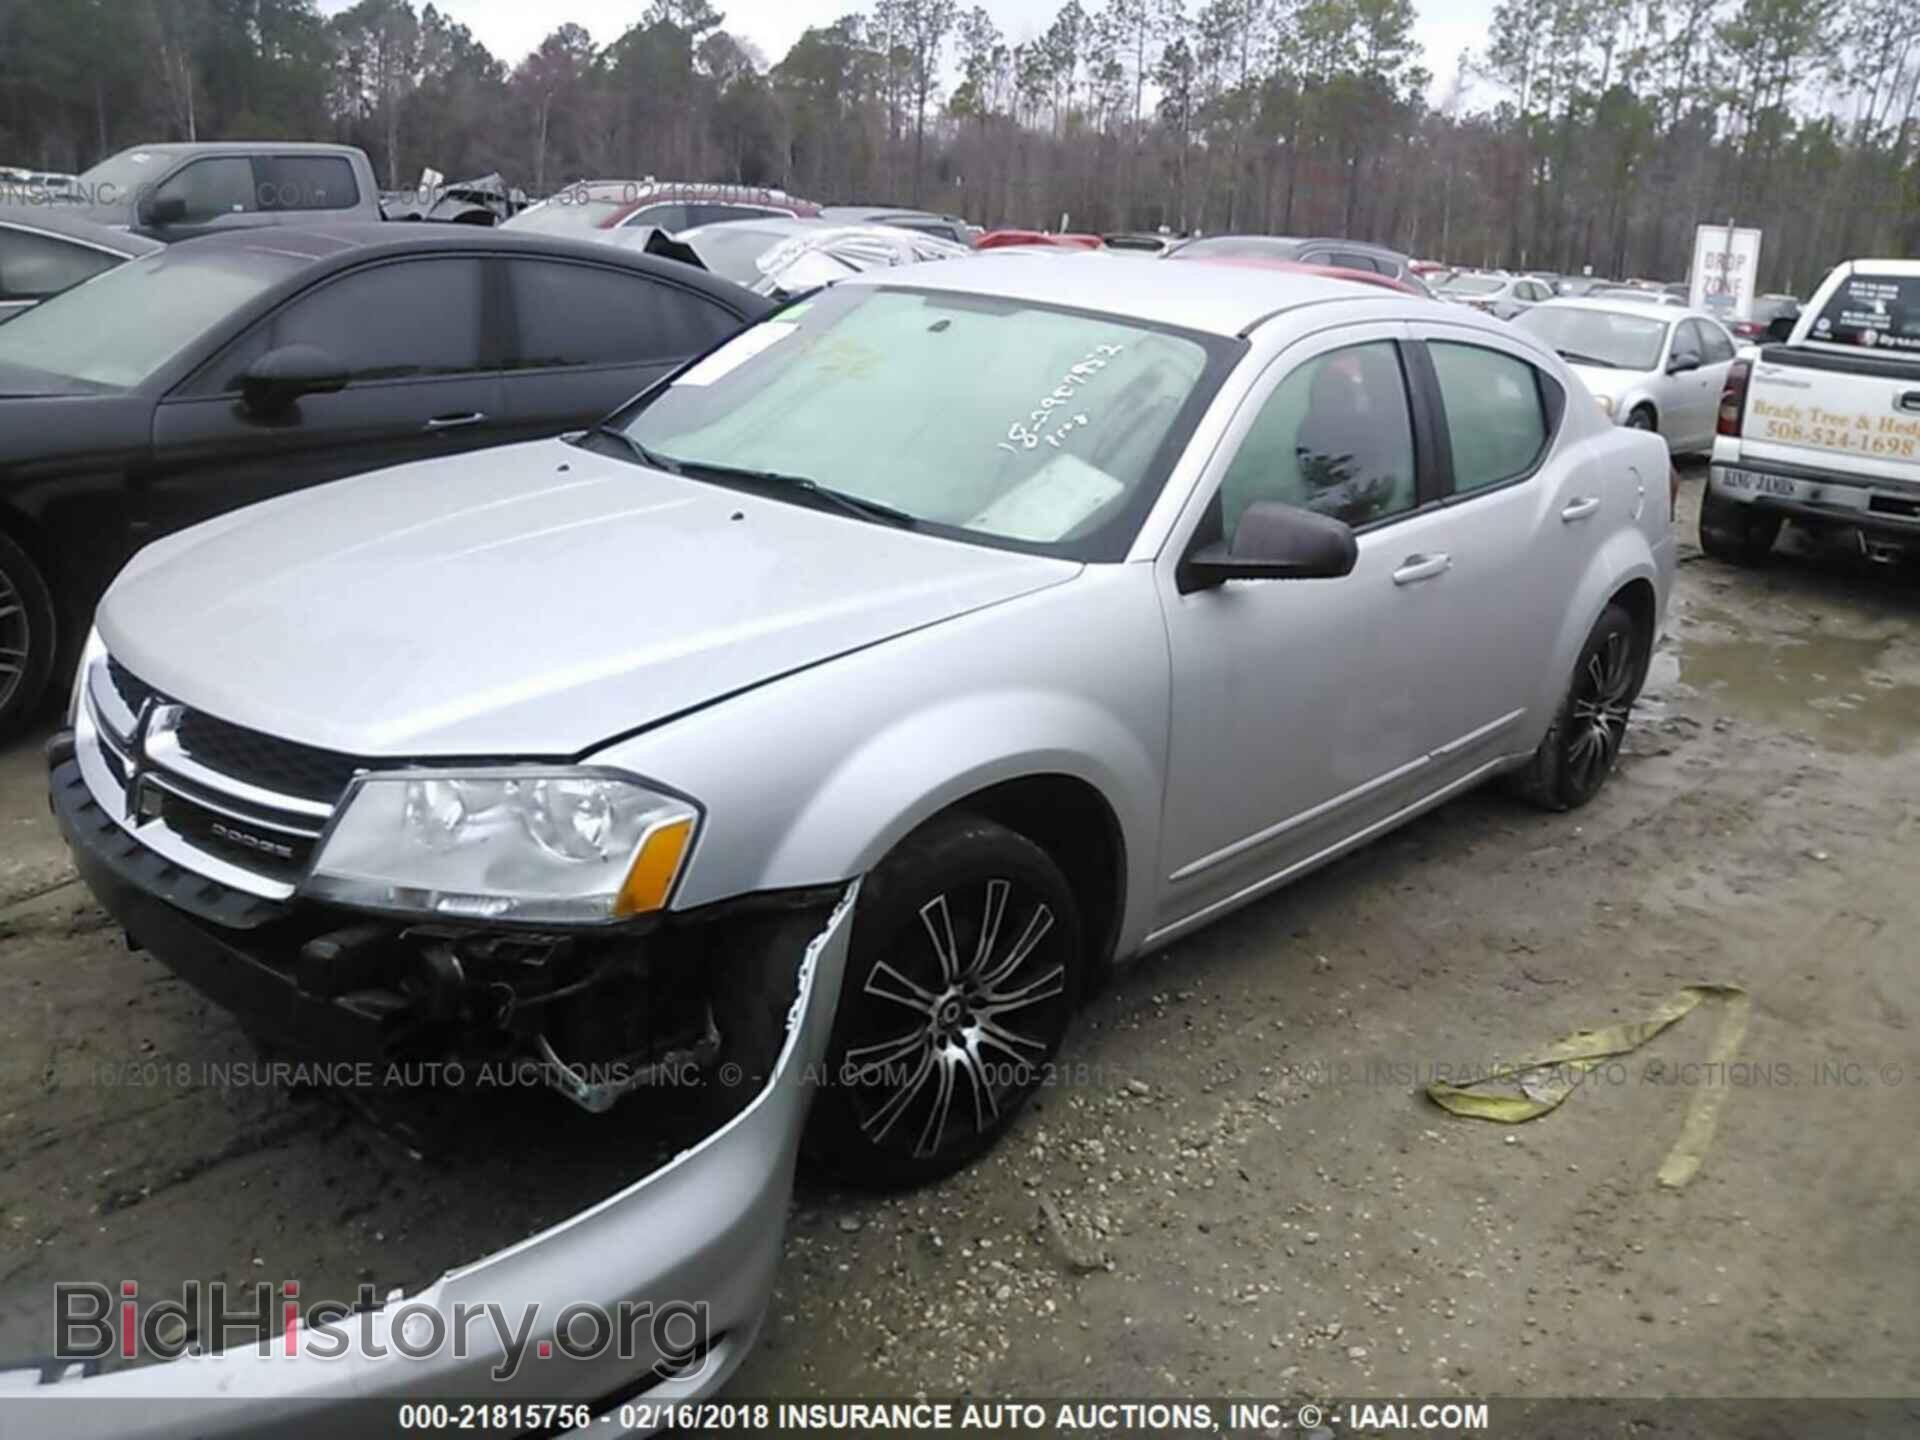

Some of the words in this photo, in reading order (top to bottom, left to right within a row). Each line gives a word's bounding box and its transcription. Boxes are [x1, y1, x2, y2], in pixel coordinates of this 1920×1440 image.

[1704, 251, 1747, 270] DROP
[1702, 274, 1743, 296] ZONE
[1753, 400, 1799, 424] Brady
[1810, 408, 1849, 427] Tree
[1855, 415, 1871, 430] &
[212, 823, 293, 858] DODGE
